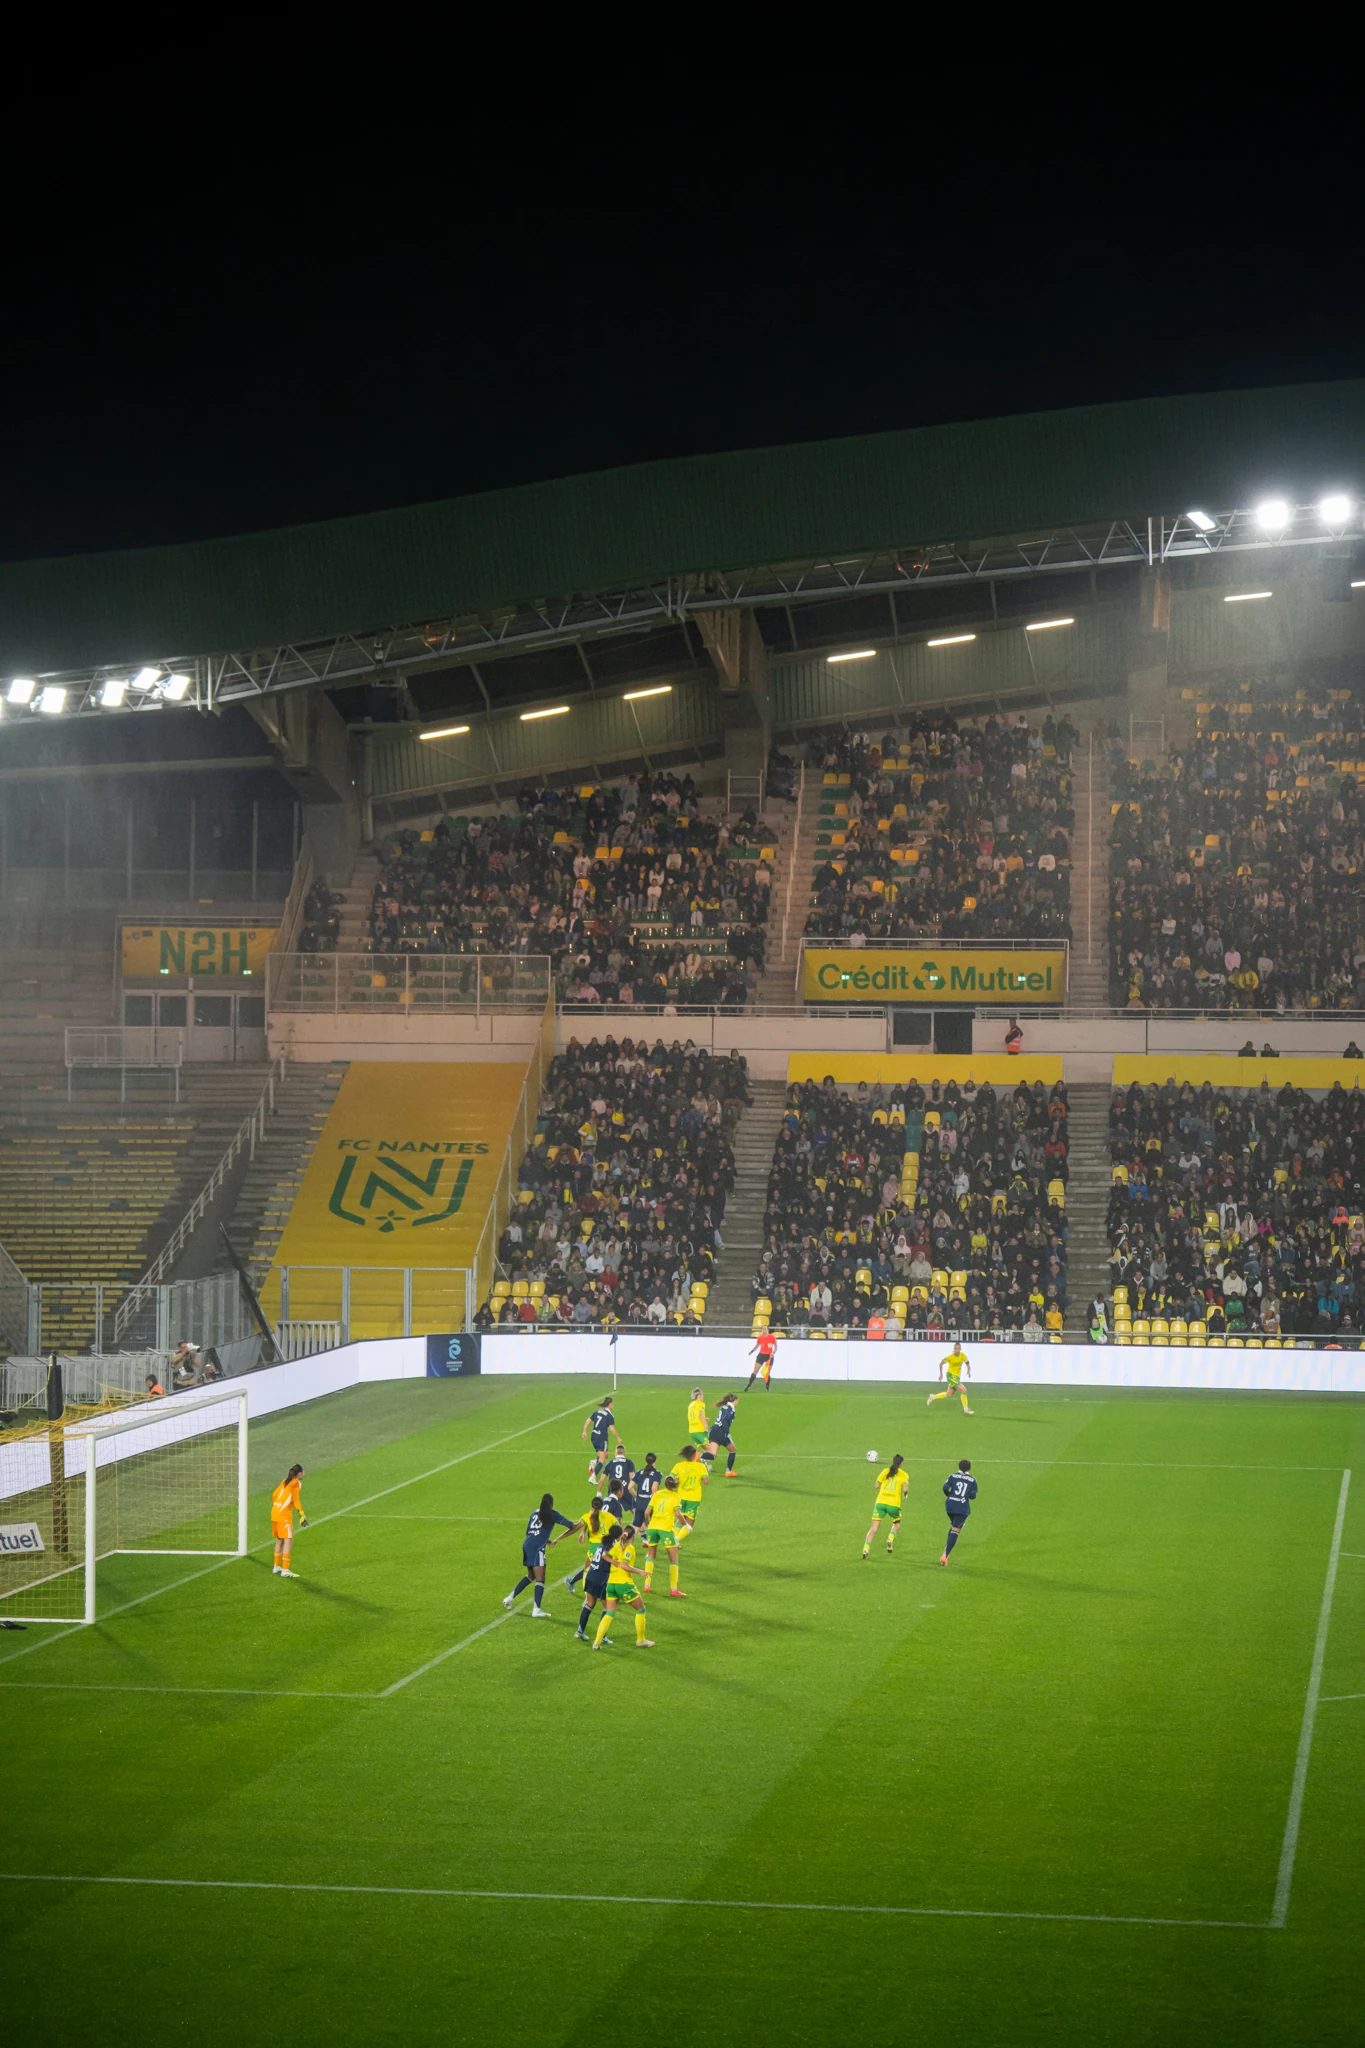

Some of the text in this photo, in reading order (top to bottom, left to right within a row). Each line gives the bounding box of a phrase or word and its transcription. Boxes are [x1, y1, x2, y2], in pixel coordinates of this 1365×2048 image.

[160, 930, 248, 975] N2H
[818, 963, 1052, 991] Crédit Mutuel
[338, 1139, 490, 1154] FC NANTES
[595, 1415, 602, 1428] 7
[615, 1464, 623, 1479] 9
[641, 1477, 650, 1493] 4
[954, 1481, 968, 1497] 31
[0, 1529, 39, 1550] tuel
